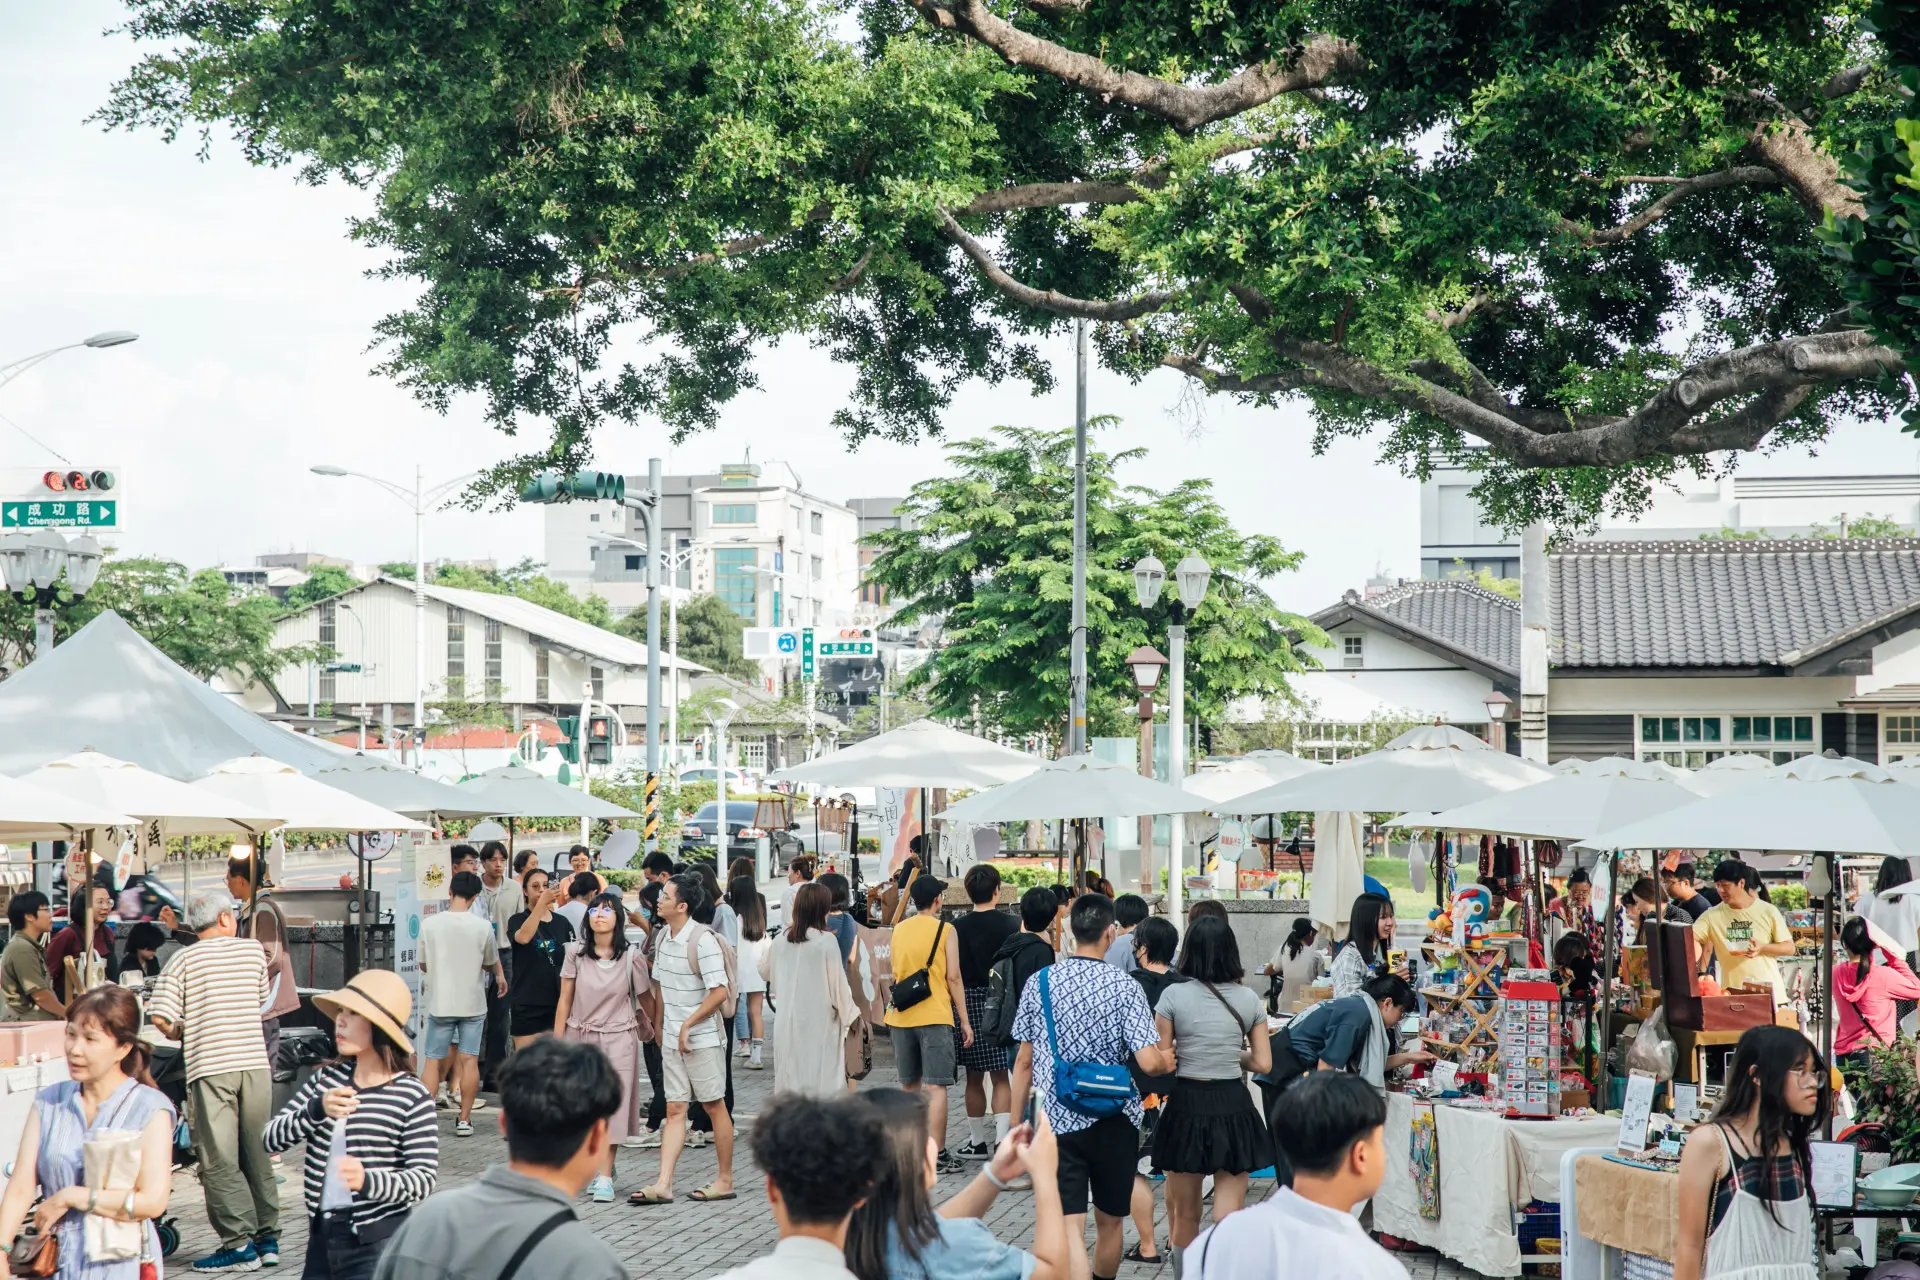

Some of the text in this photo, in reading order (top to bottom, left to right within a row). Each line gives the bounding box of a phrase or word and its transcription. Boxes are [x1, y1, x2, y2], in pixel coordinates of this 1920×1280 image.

[28, 502, 90, 516] 成功路
[27, 516, 92, 526] Chenggong Rd.
[804, 636, 812, 670] 中山路
